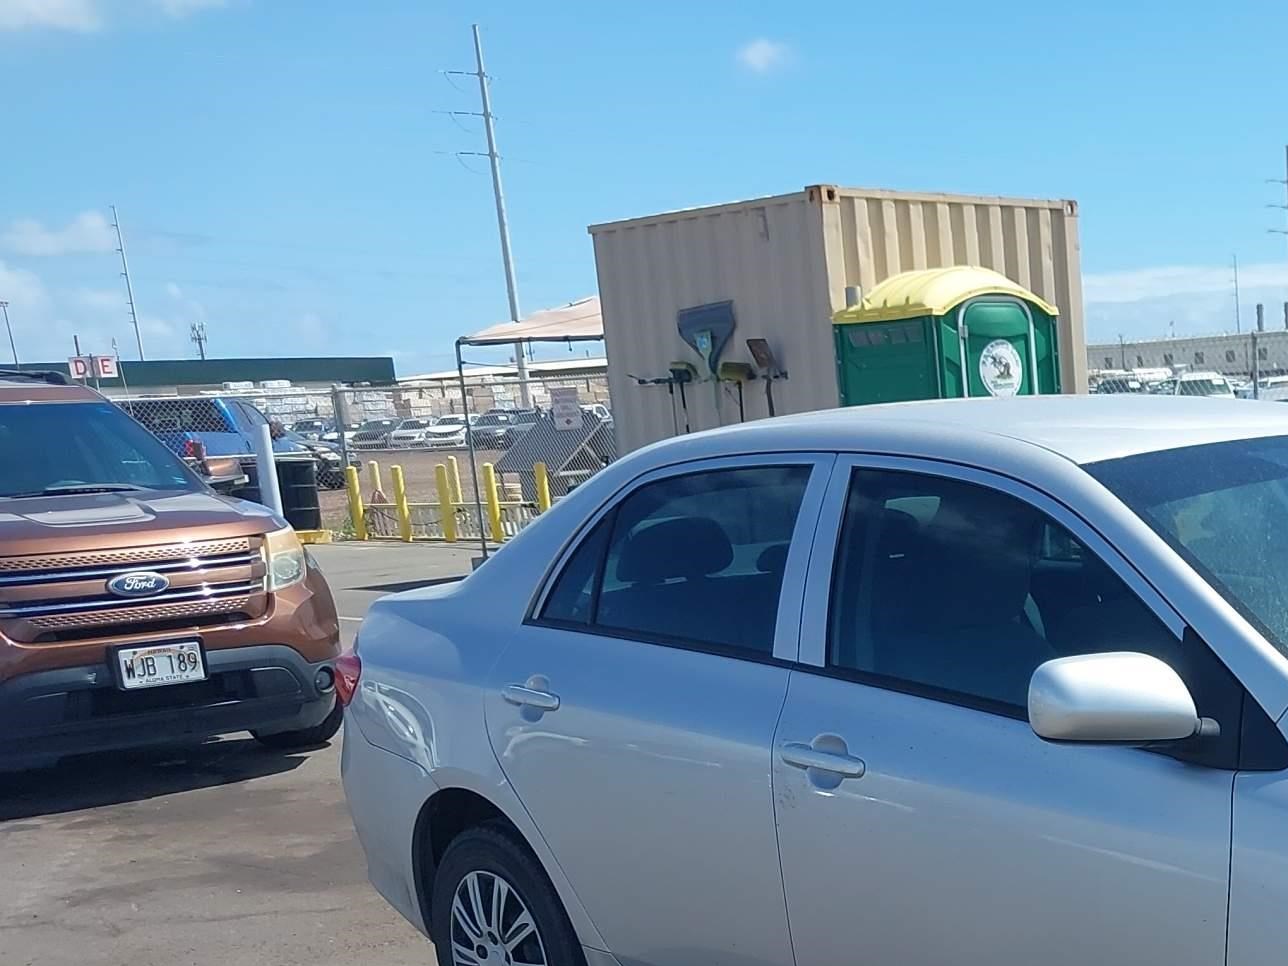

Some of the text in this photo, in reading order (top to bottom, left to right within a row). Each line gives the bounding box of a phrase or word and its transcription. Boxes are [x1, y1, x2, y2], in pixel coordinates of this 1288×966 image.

[74, 359, 87, 375] D
[100, 359, 113, 374] E
[124, 576, 156, 590] Ford
[123, 651, 198, 679] WJB 189
